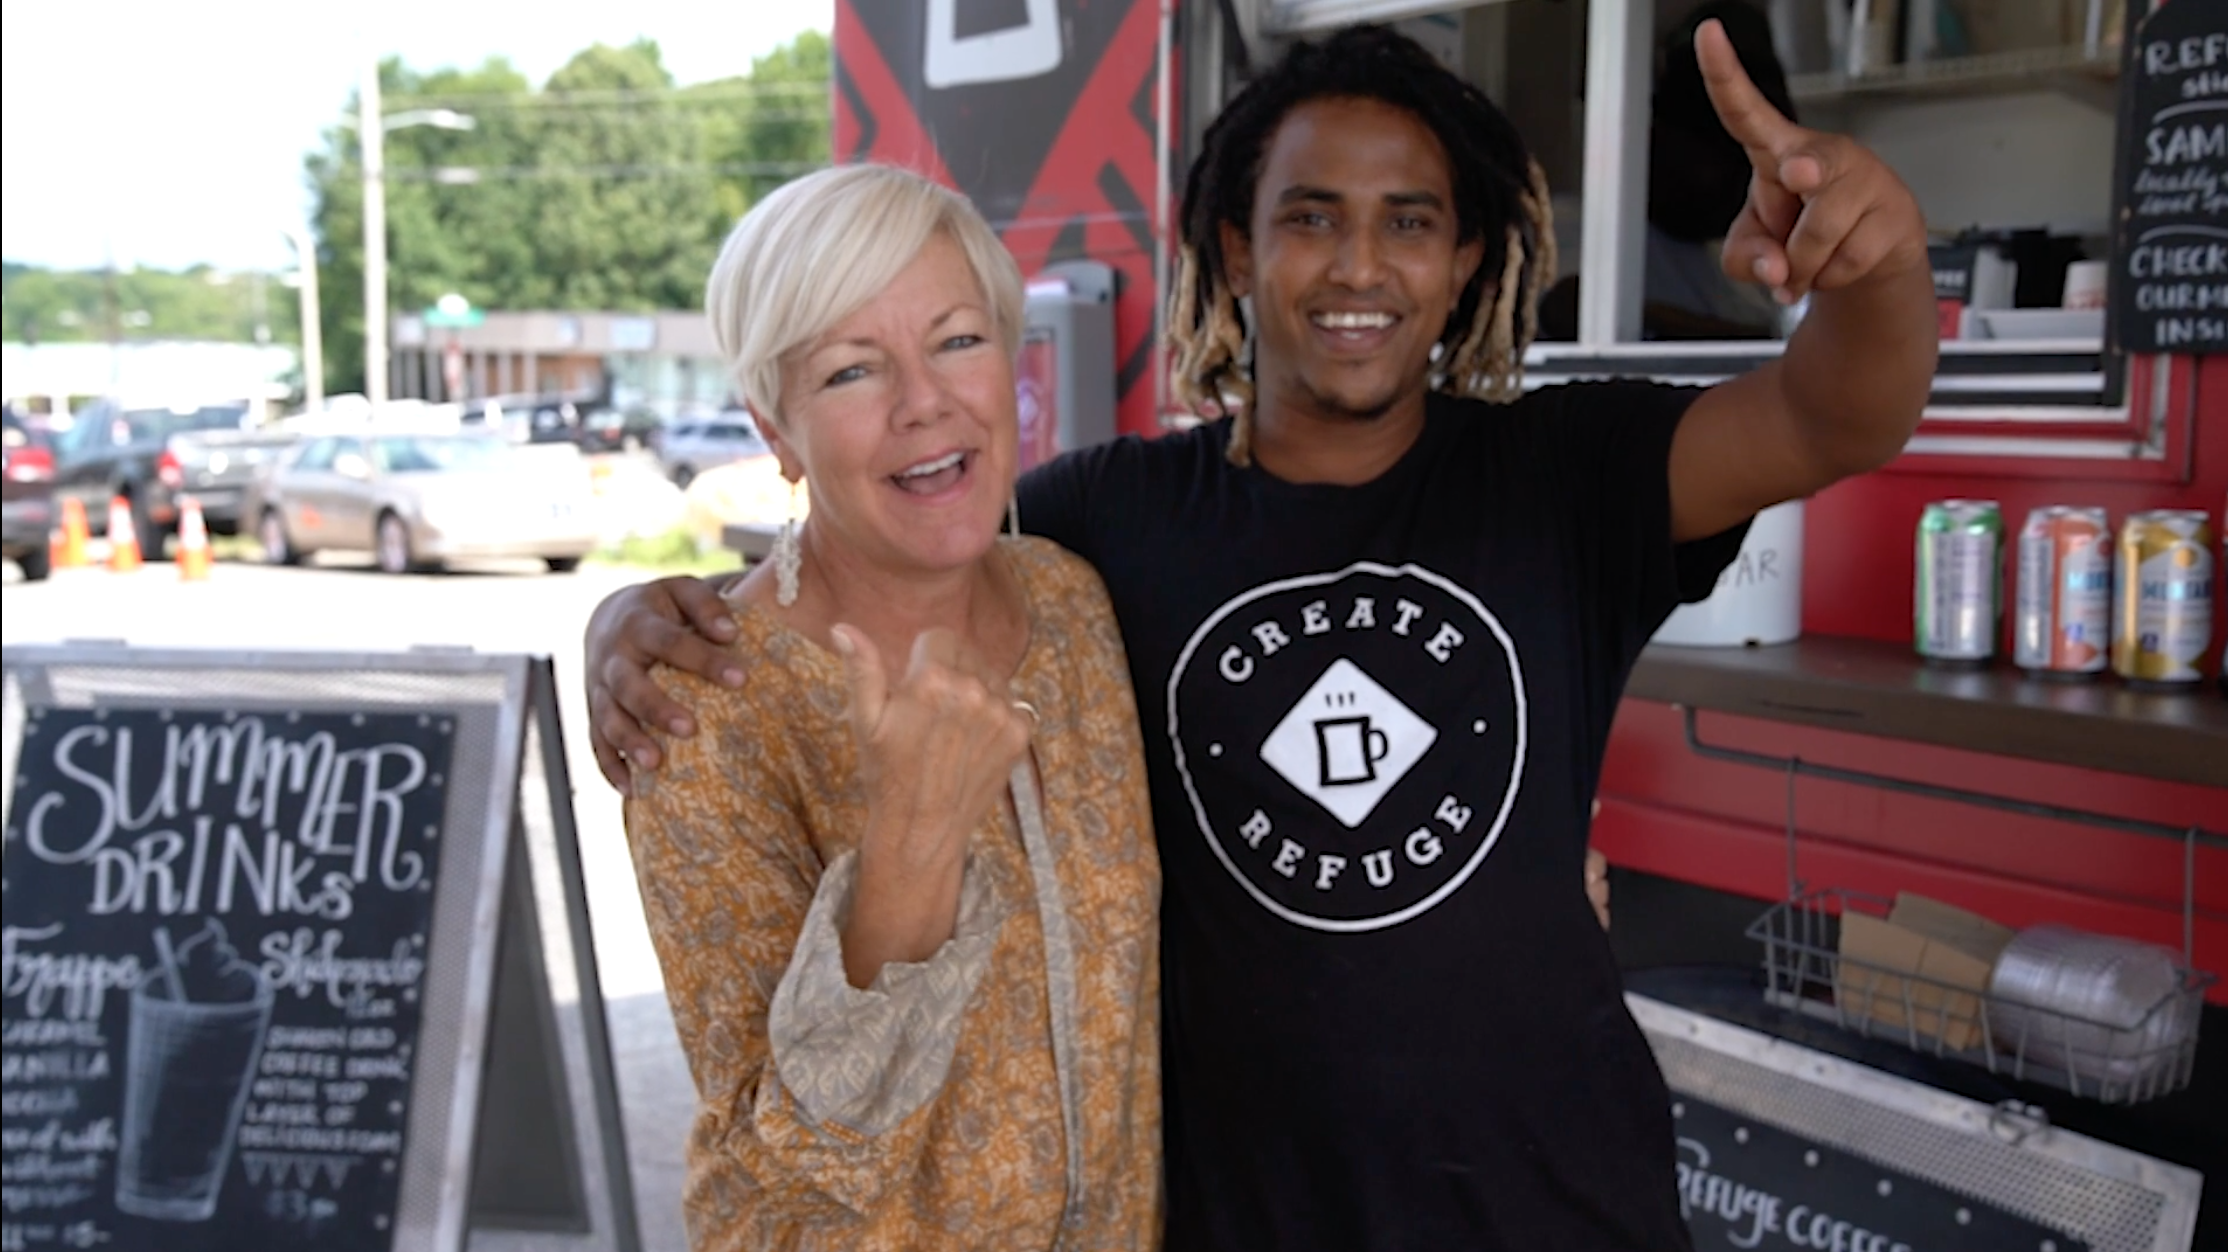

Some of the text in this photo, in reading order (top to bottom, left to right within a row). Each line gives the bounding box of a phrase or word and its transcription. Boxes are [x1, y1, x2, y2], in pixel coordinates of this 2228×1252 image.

[2145, 31, 2228, 76] REF
[2128, 242, 2228, 278] CHECK
[1718, 547, 1780, 588] AR
[1218, 597, 1465, 683] CREATE
[25, 716, 427, 892] SUMMER
[1239, 795, 1473, 890] REFUGE
[1786, 1204, 1913, 1252] COFF
